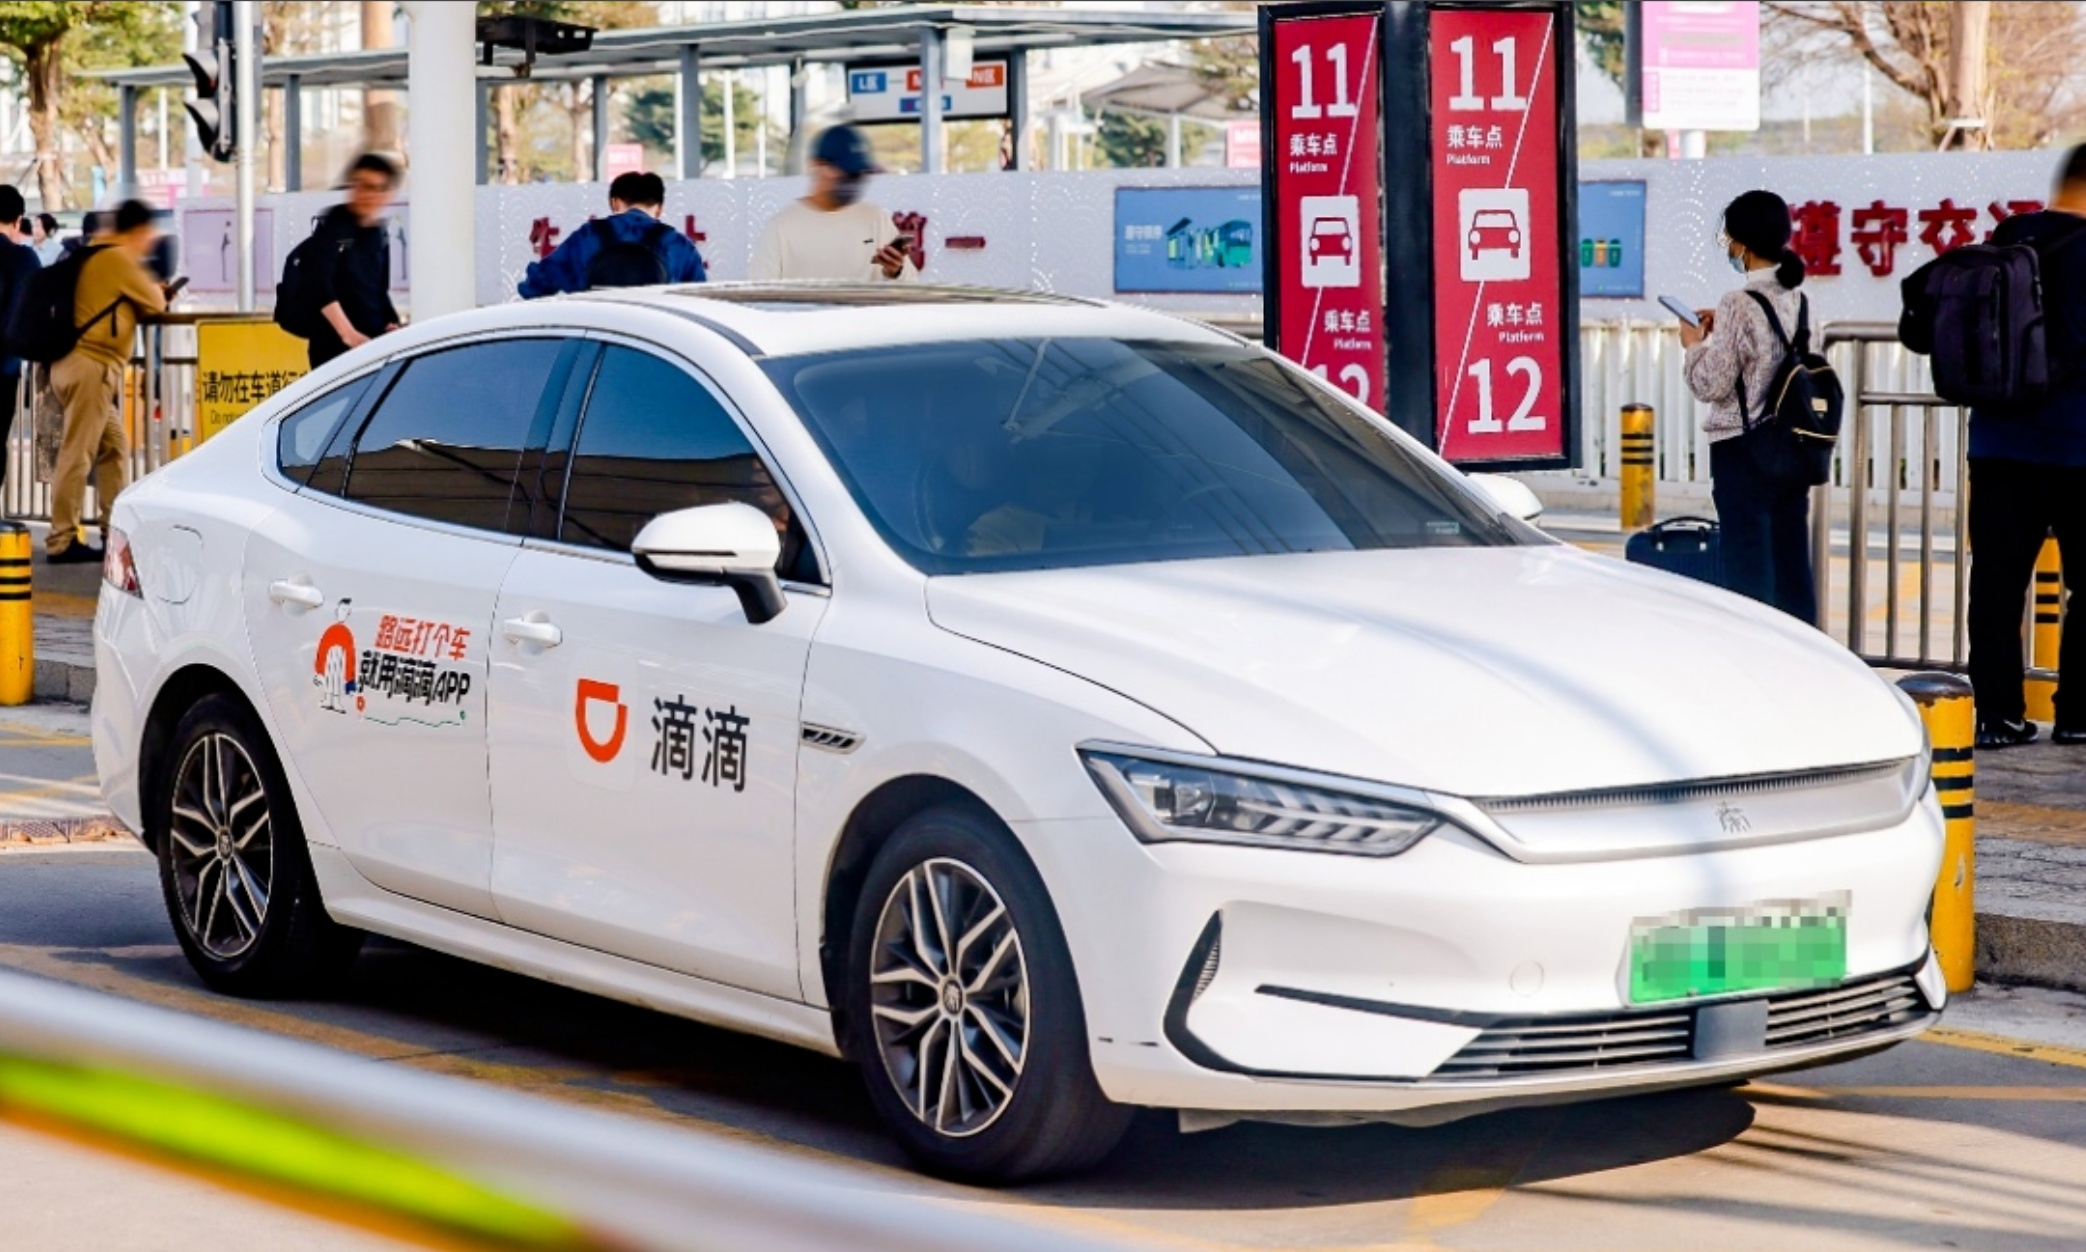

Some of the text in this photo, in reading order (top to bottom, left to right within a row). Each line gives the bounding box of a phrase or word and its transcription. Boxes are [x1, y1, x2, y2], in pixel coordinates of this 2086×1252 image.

[1291, 43, 1357, 119] 11
[1448, 35, 1527, 111] 11
[1290, 132, 1338, 156] 乘车点
[1447, 125, 1503, 149] 乘车点
[1290, 161, 1329, 173] Platform
[1446, 153, 1491, 165] Platform
[1789, 198, 2045, 277] 遵守交
[1324, 309, 1371, 333] 乘车点
[1487, 301, 1543, 327] 乘车点
[1333, 337, 1373, 350] Platform
[1498, 331, 1545, 342] Platform
[1467, 355, 1547, 434] 12
[375, 614, 471, 661] 路远打个车
[358, 649, 471, 706] 就用滴滴APP
[651, 693, 750, 793] 滴滴
